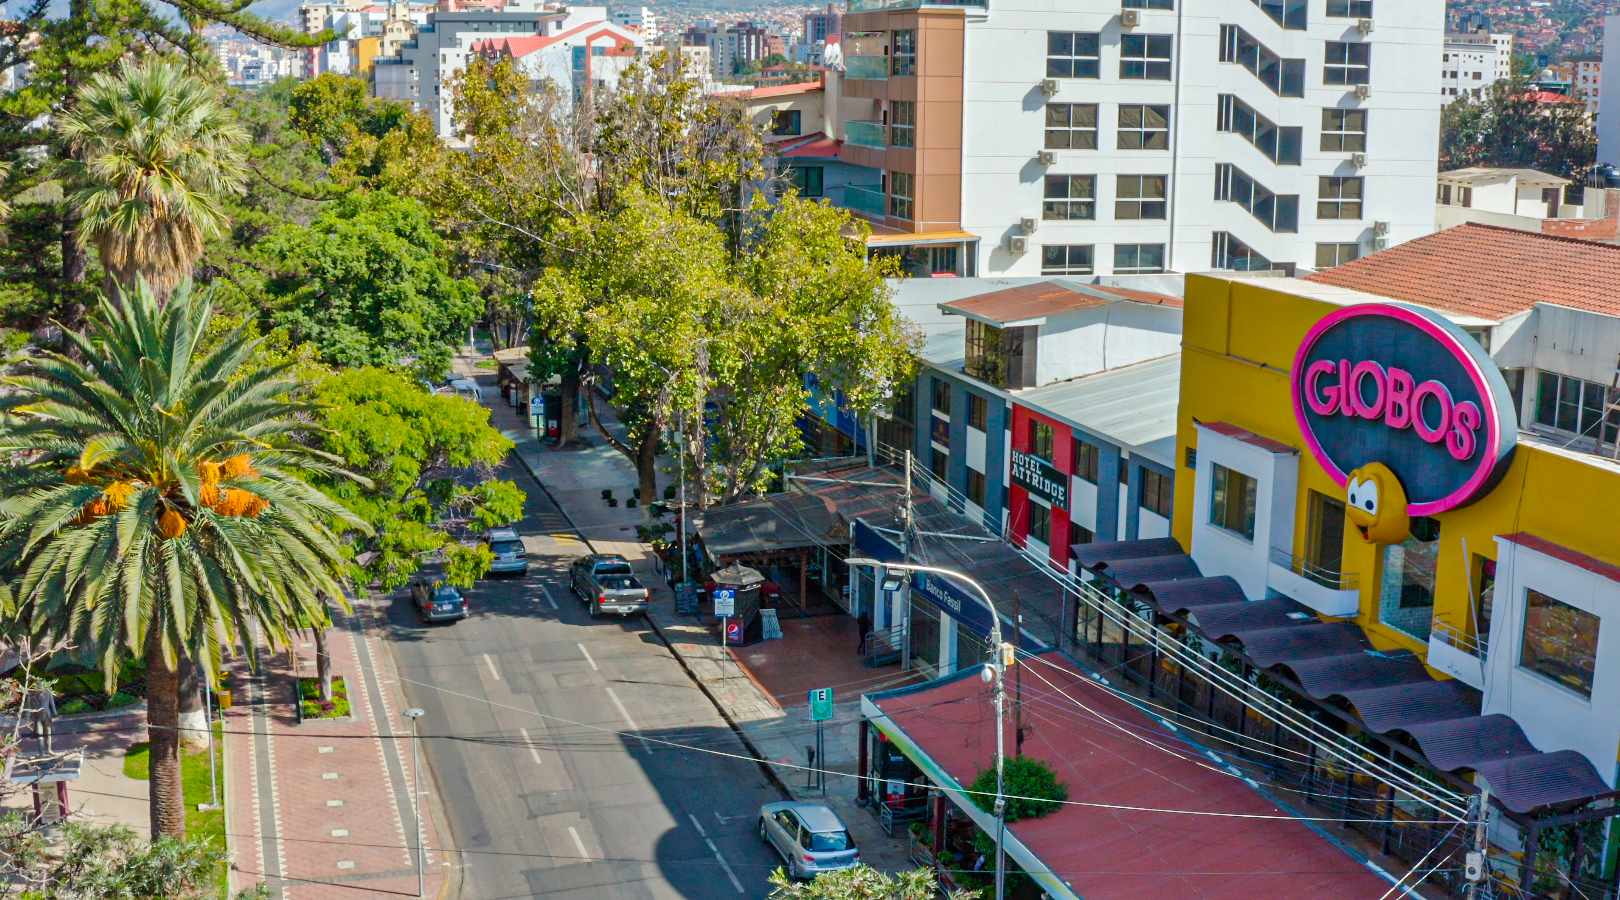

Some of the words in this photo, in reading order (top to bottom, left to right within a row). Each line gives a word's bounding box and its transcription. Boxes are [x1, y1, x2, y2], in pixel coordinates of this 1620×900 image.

[1305, 359, 1481, 460] GLOBOS
[1012, 450, 1041, 474] HOTEL
[1012, 463, 1065, 500] ATTRIDGE
[926, 578, 943, 600] Banco
[818, 690, 825, 701] E
